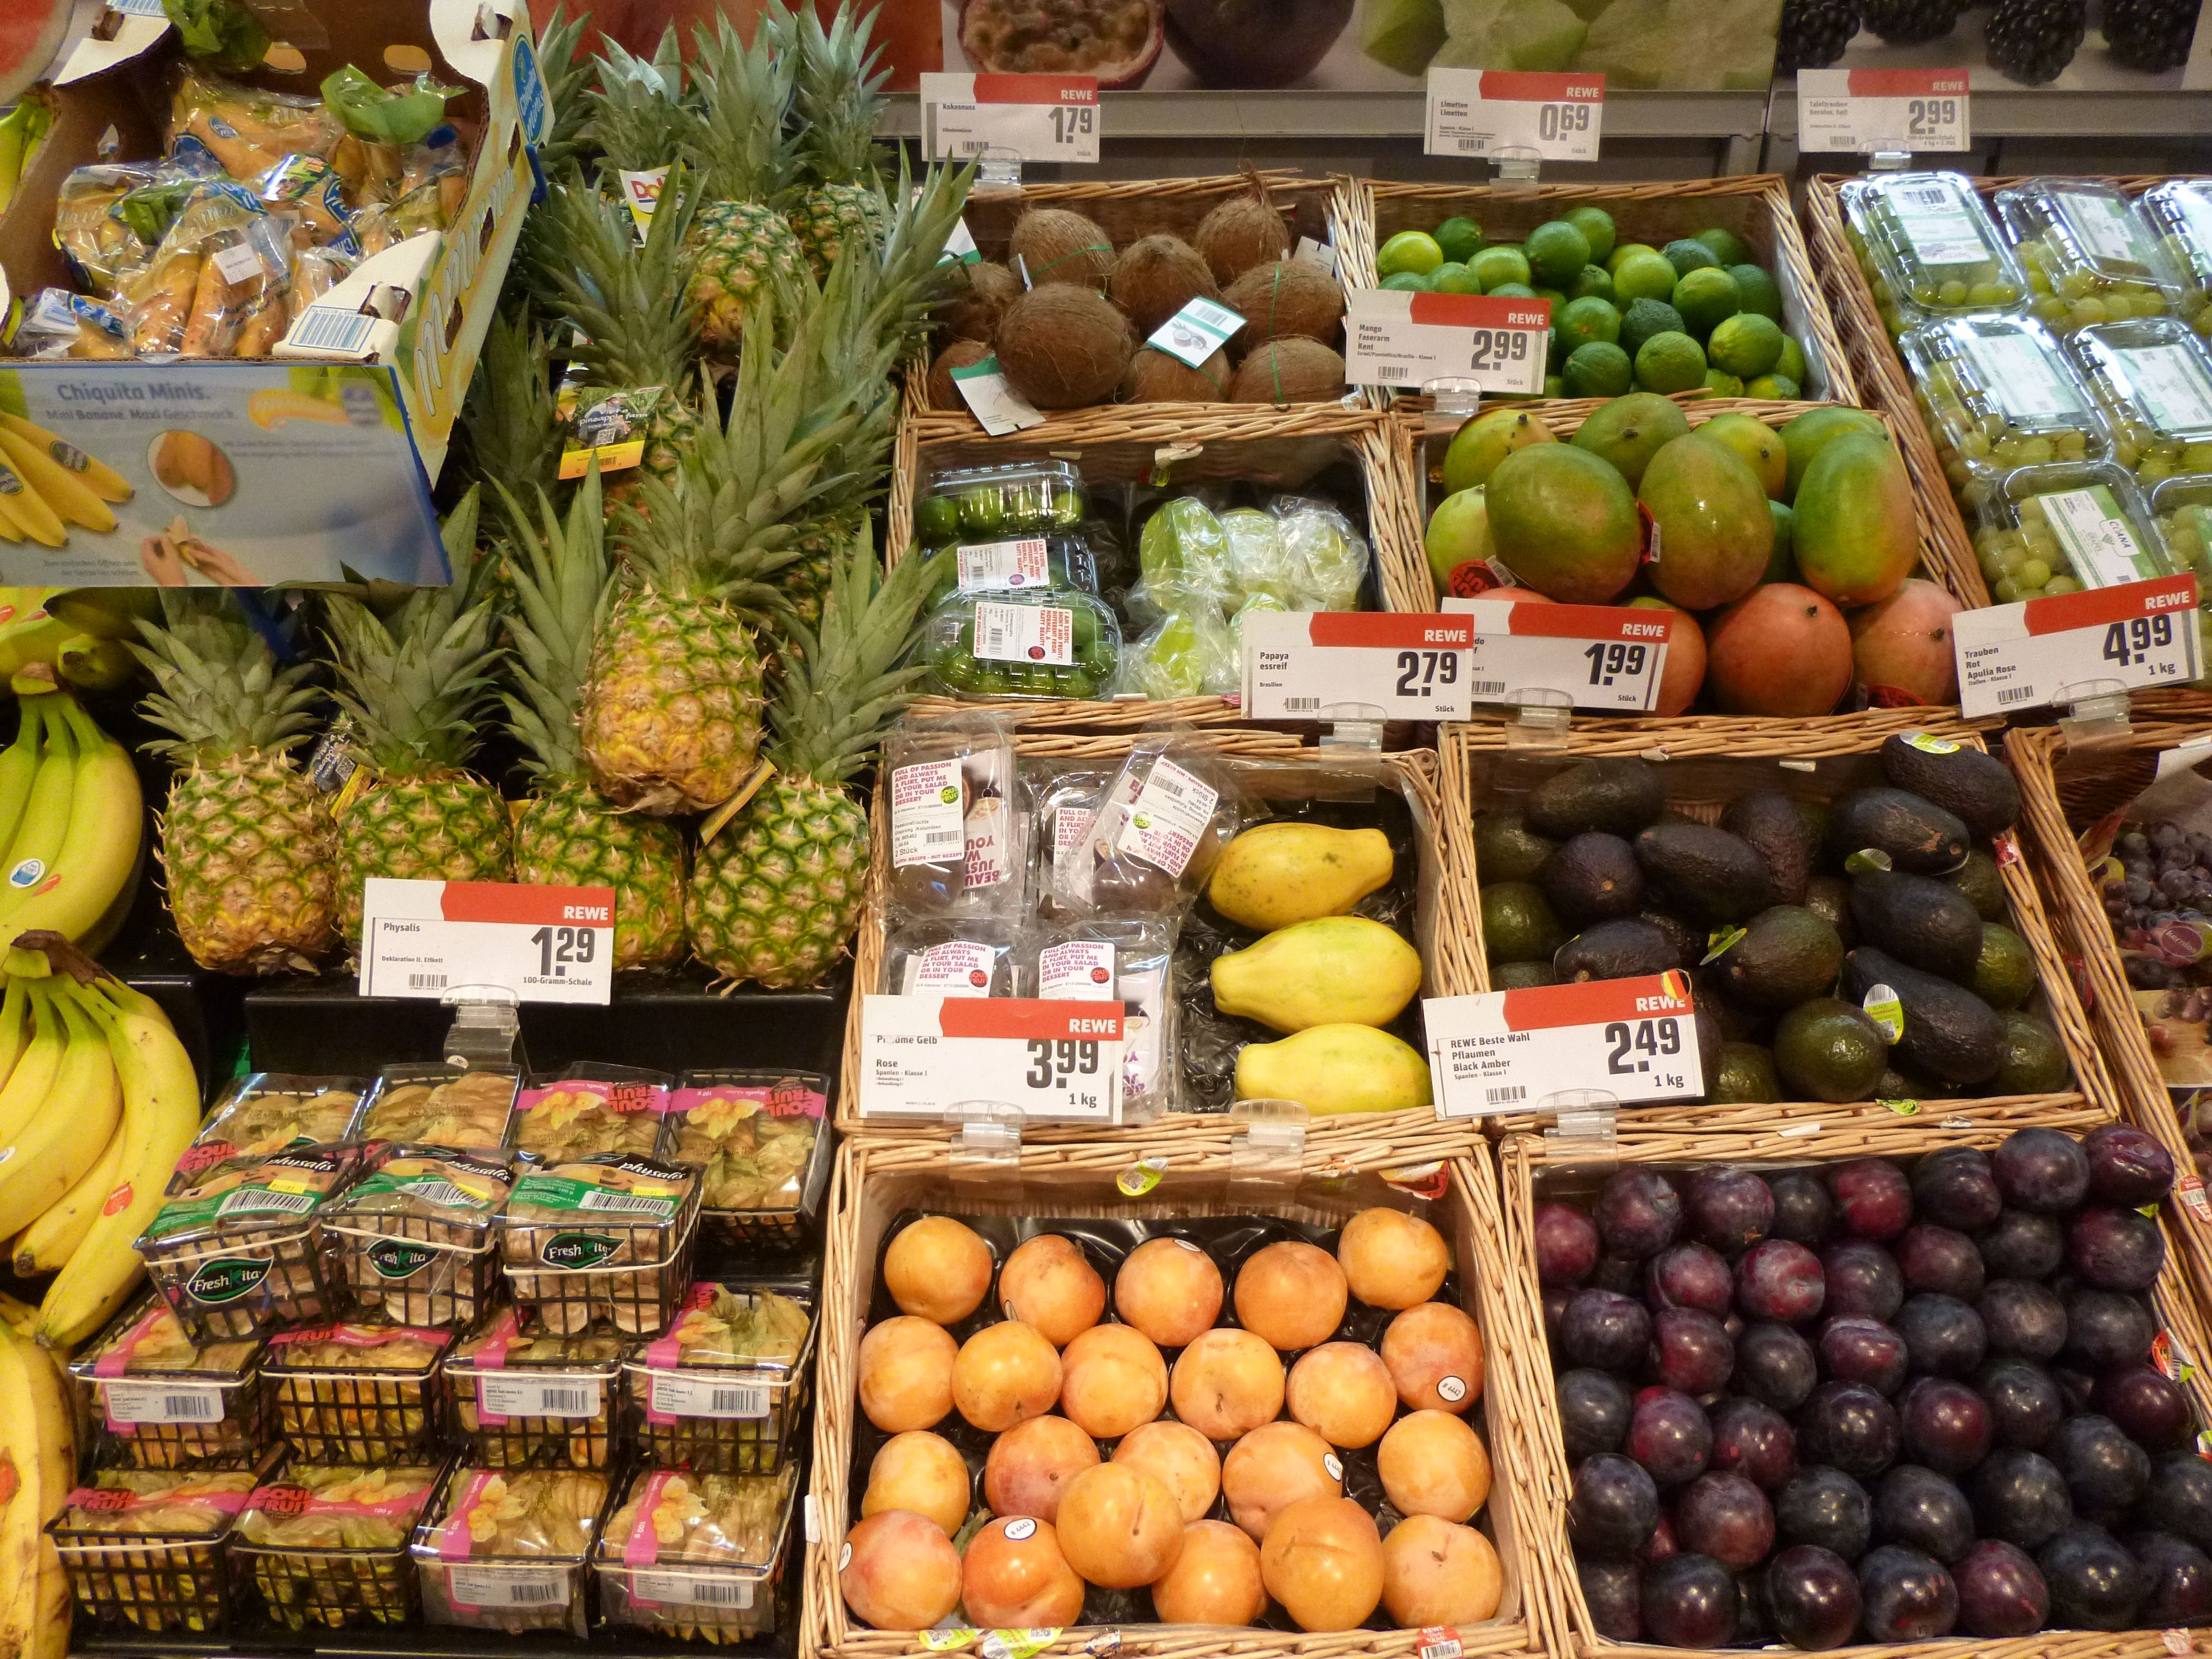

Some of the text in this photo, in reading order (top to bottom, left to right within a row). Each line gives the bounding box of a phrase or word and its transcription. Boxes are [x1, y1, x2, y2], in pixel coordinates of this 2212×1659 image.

[1566, 87, 1599, 97] REWE
[1932, 82, 1964, 91] REWE
[1061, 90, 1093, 100] REWE
[630, 177, 665, 199] Dol
[1508, 313, 1544, 325] REWE
[1359, 324, 1382, 333] Mango
[58, 385, 144, 404] Chiquita
[130, 410, 160, 420] Maxi
[580, 414, 624, 426] pineapple
[2145, 590, 2189, 610] REWE
[1425, 630, 1467, 642] REWE
[1622, 624, 1665, 637] REWE
[1260, 652, 1289, 661] Papaya
[1965, 647, 1998, 659] Trauben
[1966, 661, 1980, 669] Rot
[2149, 662, 2176, 675] 1 kg
[1968, 664, 2016, 680] Apulia Rose
[921, 762, 951, 770] PASSION
[895, 796, 922, 806] DESSERT
[894, 820, 929, 829] Passionsfrüchte
[966, 835, 995, 850] YOU
[900, 847, 918, 855] Stück
[564, 906, 608, 920] REWE
[384, 923, 421, 933] Physalis
[954, 943, 986, 951] PASSION
[2166, 930, 2197, 953] kernlos
[523, 977, 592, 986] 100-Gramm-Schale
[1042, 972, 1070, 982] DESSERT
[1636, 995, 1685, 1012] REWE
[1069, 1019, 1116, 1033] REWE
[877, 1035, 937, 1044] Pume Gelb
[1451, 1033, 1530, 1048] REWE Beste Wahl
[1452, 1049, 1495, 1060] Pflaumen
[877, 1059, 898, 1067] Rose
[1454, 1059, 1511, 1072] Black Amber
[1655, 1073, 1684, 1088] 1 kg
[1069, 1093, 1096, 1108] 1 kg
[264, 1155, 336, 1171] physalis
[446, 1160, 511, 1181] physalis
[619, 1162, 685, 1179] physalis
[1448, 1385, 1461, 1396] 4442
[1016, 1522, 1031, 1531] 4442
